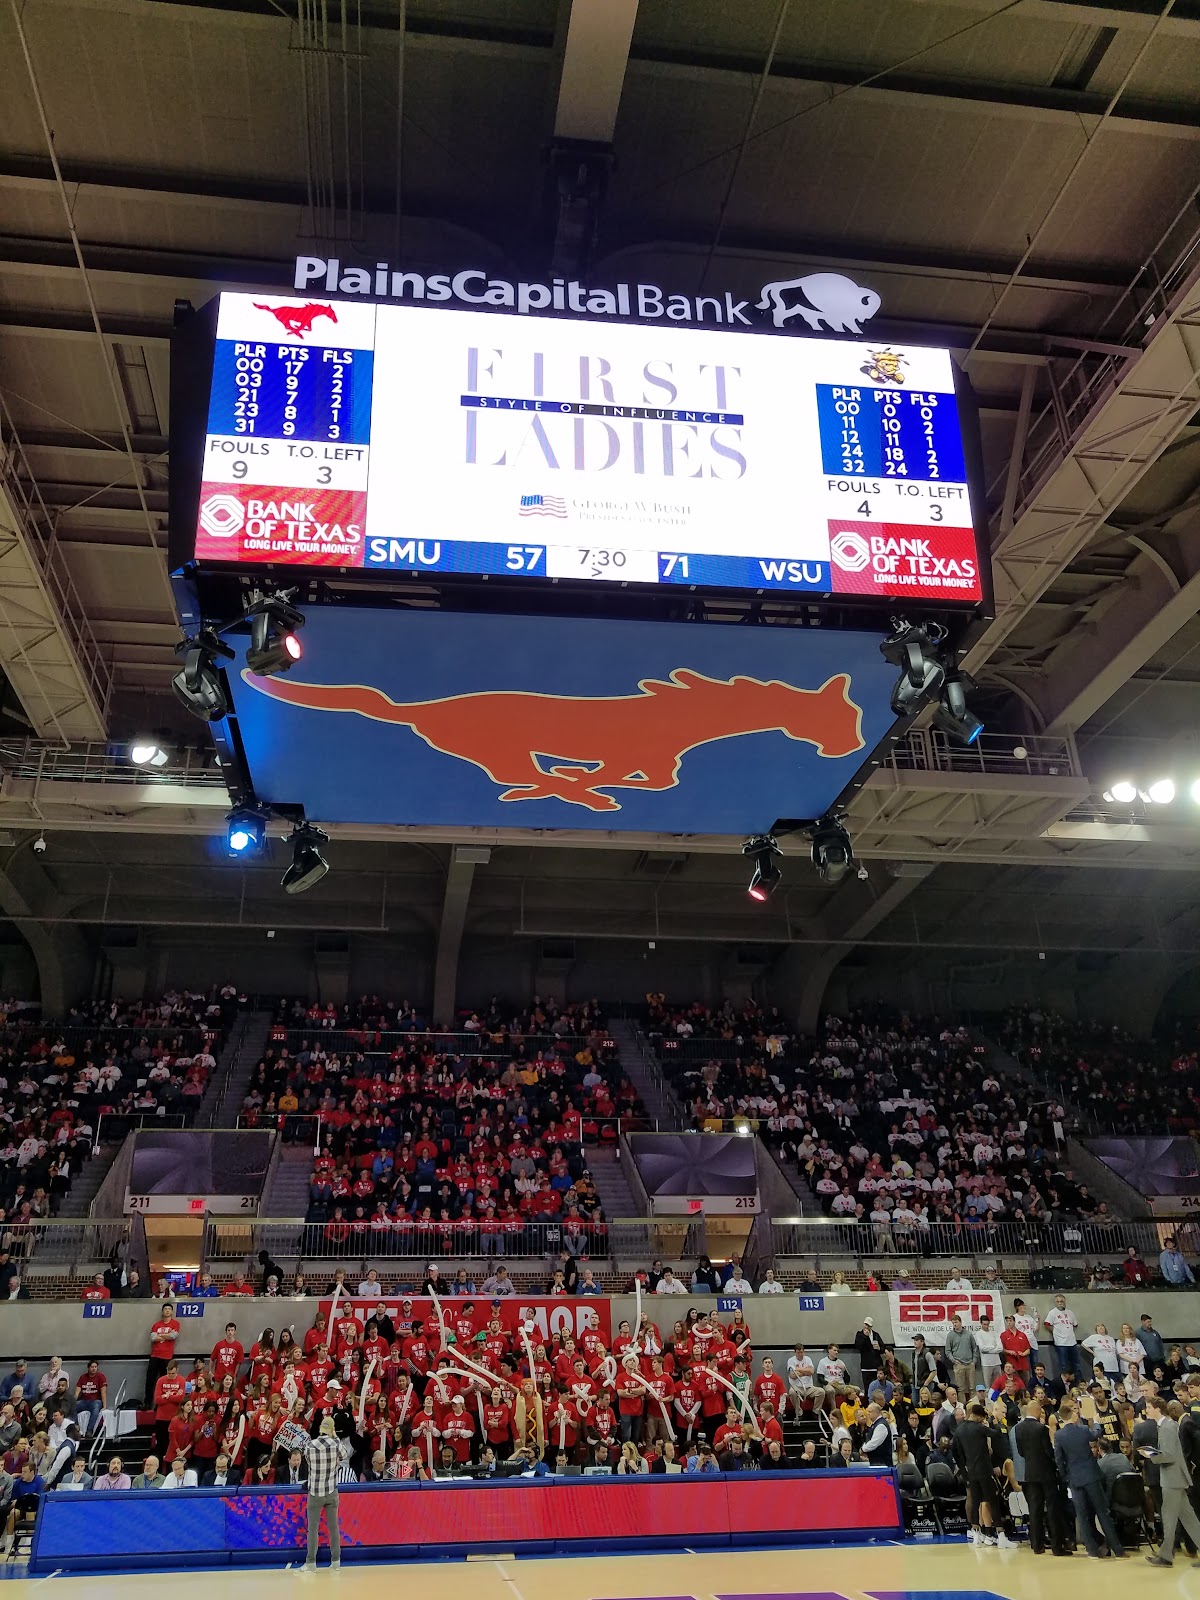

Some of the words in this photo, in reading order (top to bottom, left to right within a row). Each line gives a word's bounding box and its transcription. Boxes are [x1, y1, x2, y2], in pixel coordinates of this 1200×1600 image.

[234, 344, 266, 358] PLR
[278, 347, 309, 360] PTS
[323, 350, 352, 364] FLS
[236, 358, 264, 372] 00
[285, 362, 303, 374] 17
[332, 365, 343, 378] 2
[235, 373, 262, 387] 03
[286, 376, 298, 390] 9
[331, 380, 342, 393] 2
[467, 347, 741, 410] FIRST
[238, 388, 257, 402] 21
[286, 392, 298, 404] 7
[330, 395, 342, 408] 2
[832, 388, 861, 401] PLR
[874, 391, 902, 404] PTS
[910, 393, 938, 407] FLS
[234, 403, 258, 417] 23
[284, 406, 297, 420] 8
[332, 409, 338, 422] 1
[480, 397, 542, 411] STYLE
[560, 403, 585, 414] OF
[602, 406, 726, 424] INFLUENCE
[835, 401, 860, 415] 00
[884, 404, 896, 417] 0
[920, 407, 933, 420] 0
[234, 418, 254, 432] 31
[282, 422, 295, 435] 9
[328, 425, 340, 438] 3
[842, 416, 855, 429] 11
[882, 419, 901, 432] 10
[923, 422, 934, 435] 2
[464, 410, 747, 480] LADIES
[842, 430, 859, 444] 12
[886, 433, 900, 446] 11
[926, 436, 933, 449] 1
[210, 440, 270, 455] FOULS
[287, 445, 318, 458] T.O.
[324, 448, 364, 461] LEFT
[841, 444, 863, 458] 24
[885, 448, 904, 461] 18
[927, 451, 938, 464] 2
[232, 460, 248, 479] 9
[316, 466, 332, 484] 3
[842, 459, 865, 473] 32
[885, 462, 908, 476] 24
[928, 465, 940, 478] 2
[828, 480, 881, 494] FOULS
[895, 484, 924, 497] T.O.
[929, 486, 964, 499] LEFT
[247, 500, 316, 522] BANK
[857, 500, 872, 518] 4
[929, 504, 943, 521] 3
[246, 520, 277, 538] OF
[284, 521, 361, 543] TEXAS
[244, 539, 270, 550] LONG
[272, 540, 293, 551] LIVE
[294, 541, 320, 553] YOUR
[369, 538, 441, 565] SMU
[870, 536, 933, 558] BANK
[506, 546, 544, 571] 57
[578, 549, 627, 567] 7:30
[660, 554, 689, 578] 71
[872, 555, 900, 573] OF
[905, 556, 976, 578] TEXAS
[759, 560, 822, 584] WSU
[873, 573, 897, 584] LONG
[898, 574, 917, 585] LIVE
[918, 576, 941, 587] YOUR
[130, 1197, 150, 1208] 211
[735, 1198, 755, 1208] 213
[1181, 1197, 1200, 1207] 214
[91, 1305, 106, 1316] 111
[182, 1304, 199, 1315] 112
[722, 1300, 738, 1310] 112
[804, 1299, 820, 1309] 113
[899, 1294, 994, 1322] ESPN
